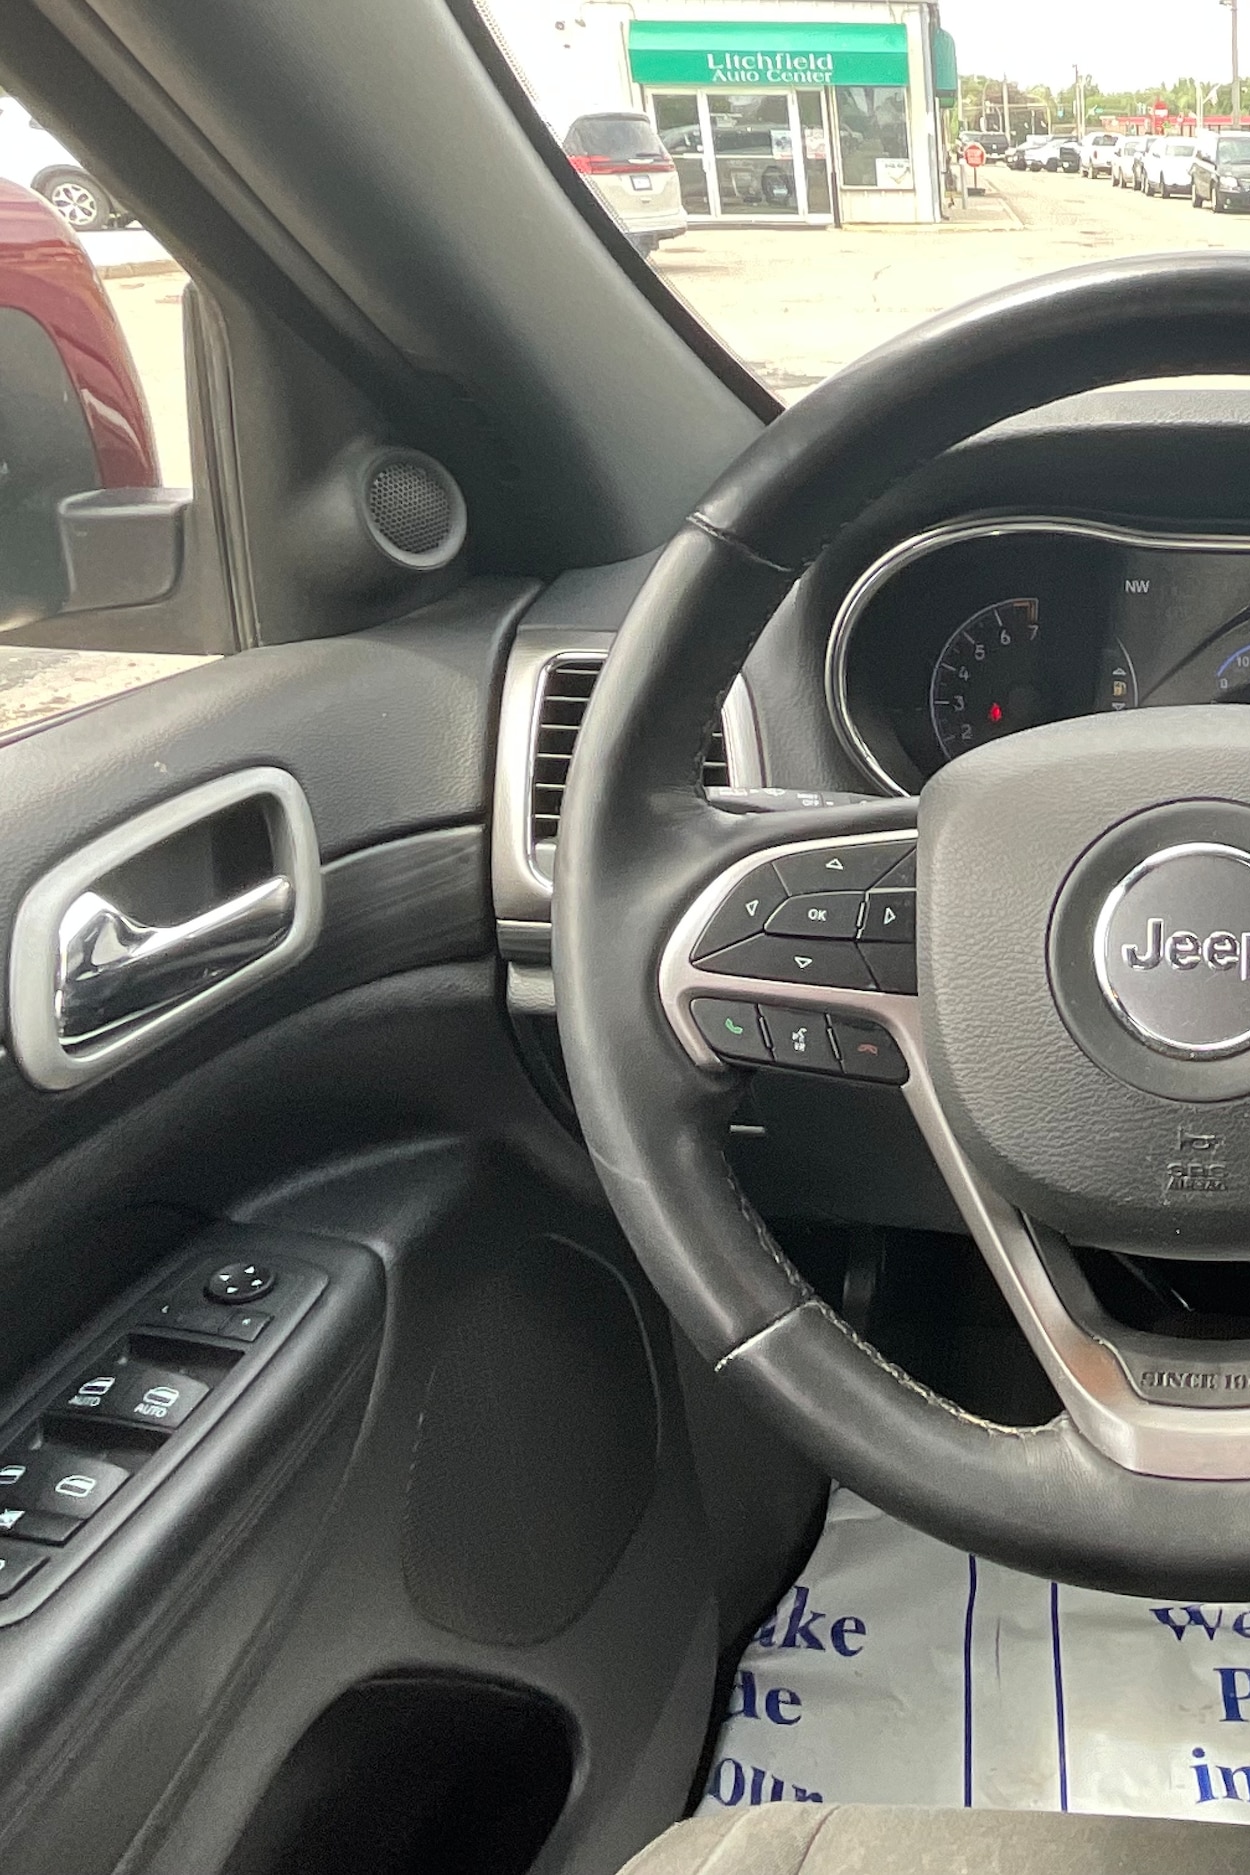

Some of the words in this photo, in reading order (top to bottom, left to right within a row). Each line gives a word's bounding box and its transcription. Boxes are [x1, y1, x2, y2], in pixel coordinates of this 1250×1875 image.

[707, 52, 833, 70] Litchfield
[712, 69, 759, 82] Auto
[766, 69, 832, 83] Center
[1125, 579, 1150, 593] NW
[1001, 630, 1011, 645] 6
[1028, 625, 1039, 640] 7
[975, 645, 985, 661] 5
[1237, 656, 1249, 667] 10
[959, 667, 970, 681] 4
[953, 696, 964, 711] 3
[961, 724, 973, 740] 2
[808, 908, 827, 922] OK
[1140, 1371, 1217, 1389] SINCE
[67, 1395, 101, 1407] AUTO
[133, 1403, 168, 1418] AUTO
